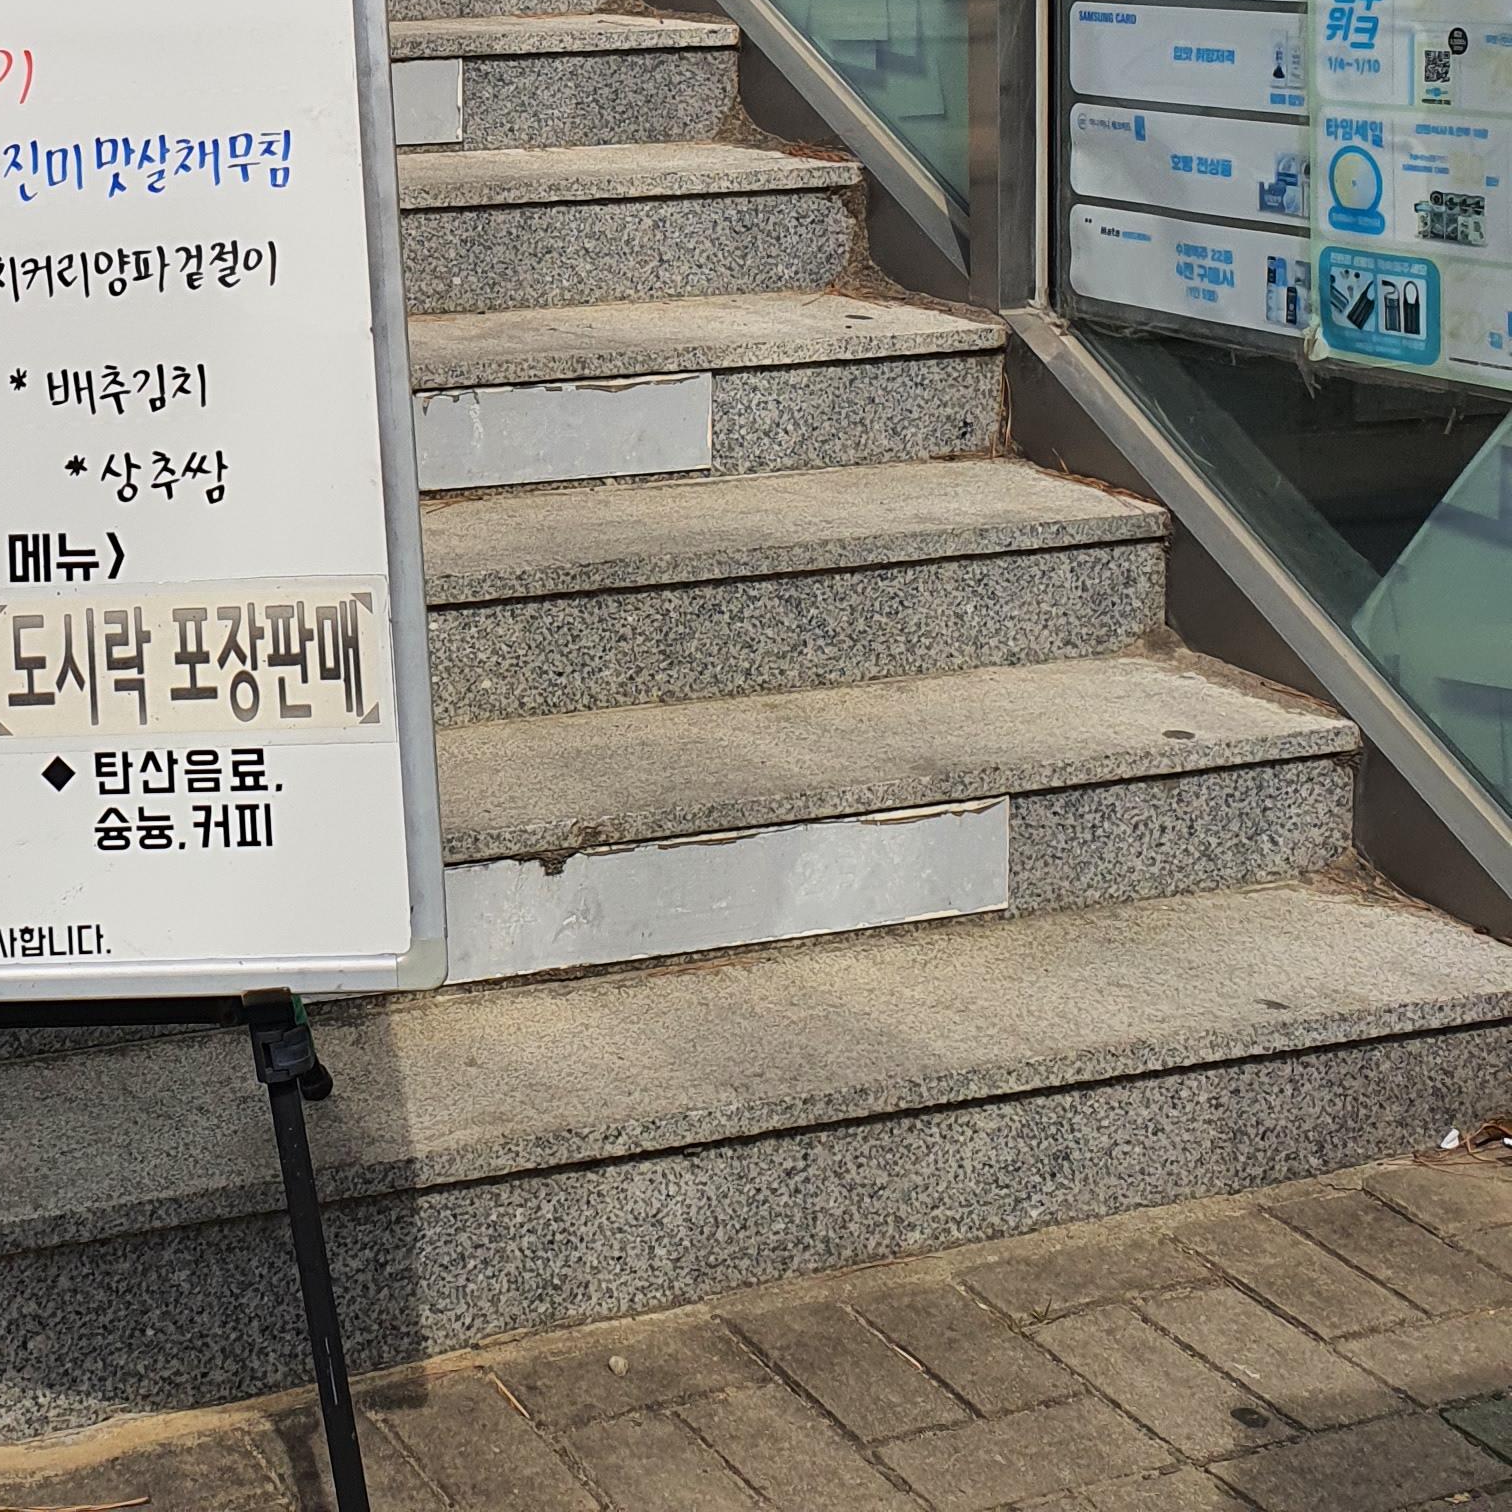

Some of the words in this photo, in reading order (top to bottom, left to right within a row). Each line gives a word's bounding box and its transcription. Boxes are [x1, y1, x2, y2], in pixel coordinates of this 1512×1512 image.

[1115, 12, 1137, 25] CARD
[1326, 6, 1379, 50] 위크
[46, 362, 209, 416] 배추김치
[99, 449, 231, 505] 상추쌈
[7, 605, 153, 727] 도시락
[169, 598, 366, 726] 포장판매
